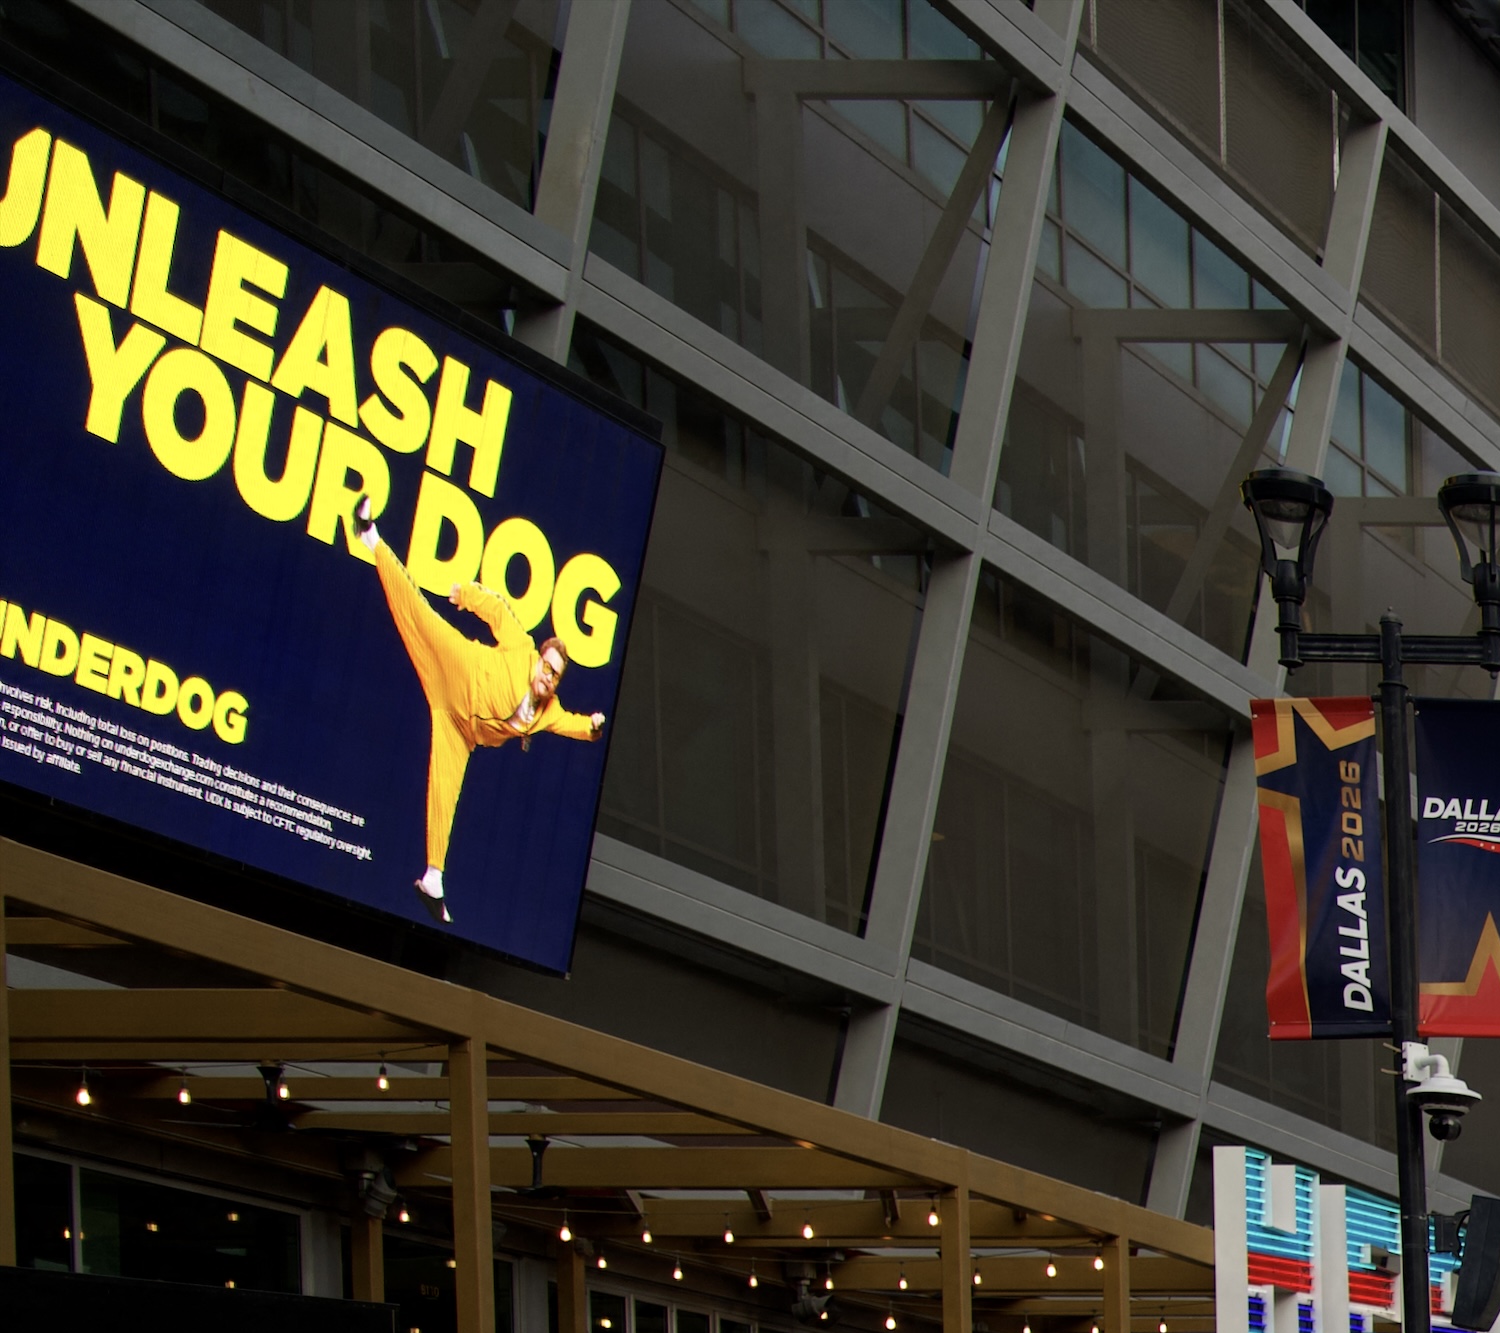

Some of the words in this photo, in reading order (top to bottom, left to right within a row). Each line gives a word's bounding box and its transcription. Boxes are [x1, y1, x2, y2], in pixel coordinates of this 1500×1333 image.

[74, 293, 391, 564] YOUR
[406, 470, 623, 667] DOG
[0, 600, 249, 745] NDERDOG
[1, 734, 32, 758] issued
[33, 748, 46, 765] by
[7, 720, 21, 733] or
[20, 724, 44, 741] offer
[44, 732, 56, 746] to
[56, 735, 75, 756] buy
[75, 744, 87, 758] or
[86, 747, 103, 763] sell
[103, 754, 120, 773] any
[120, 758, 157, 782] financial
[223, 797, 232, 810] is
[232, 801, 263, 822] subject
[262, 810, 273, 825] to
[273, 815, 296, 833] CFTC
[296, 824, 336, 849] regulatory
[64, 721, 101, 748] Nothing
[101, 736, 114, 750] on
[114, 740, 215, 788] underdogexchange.com
[214, 778, 259, 804] constitutes
[97, 717, 119, 736] total
[119, 725, 137, 743] loss
[136, 732, 150, 748] on
[191, 752, 223, 777] Trading
[223, 764, 261, 789] decisions
[261, 779, 278, 796] and
[277, 782, 298, 803] their
[296, 793, 352, 822] consequences
[351, 813, 366, 828] are
[1339, 758, 1365, 863] 2026
[1334, 864, 1375, 1014] DALLAS
